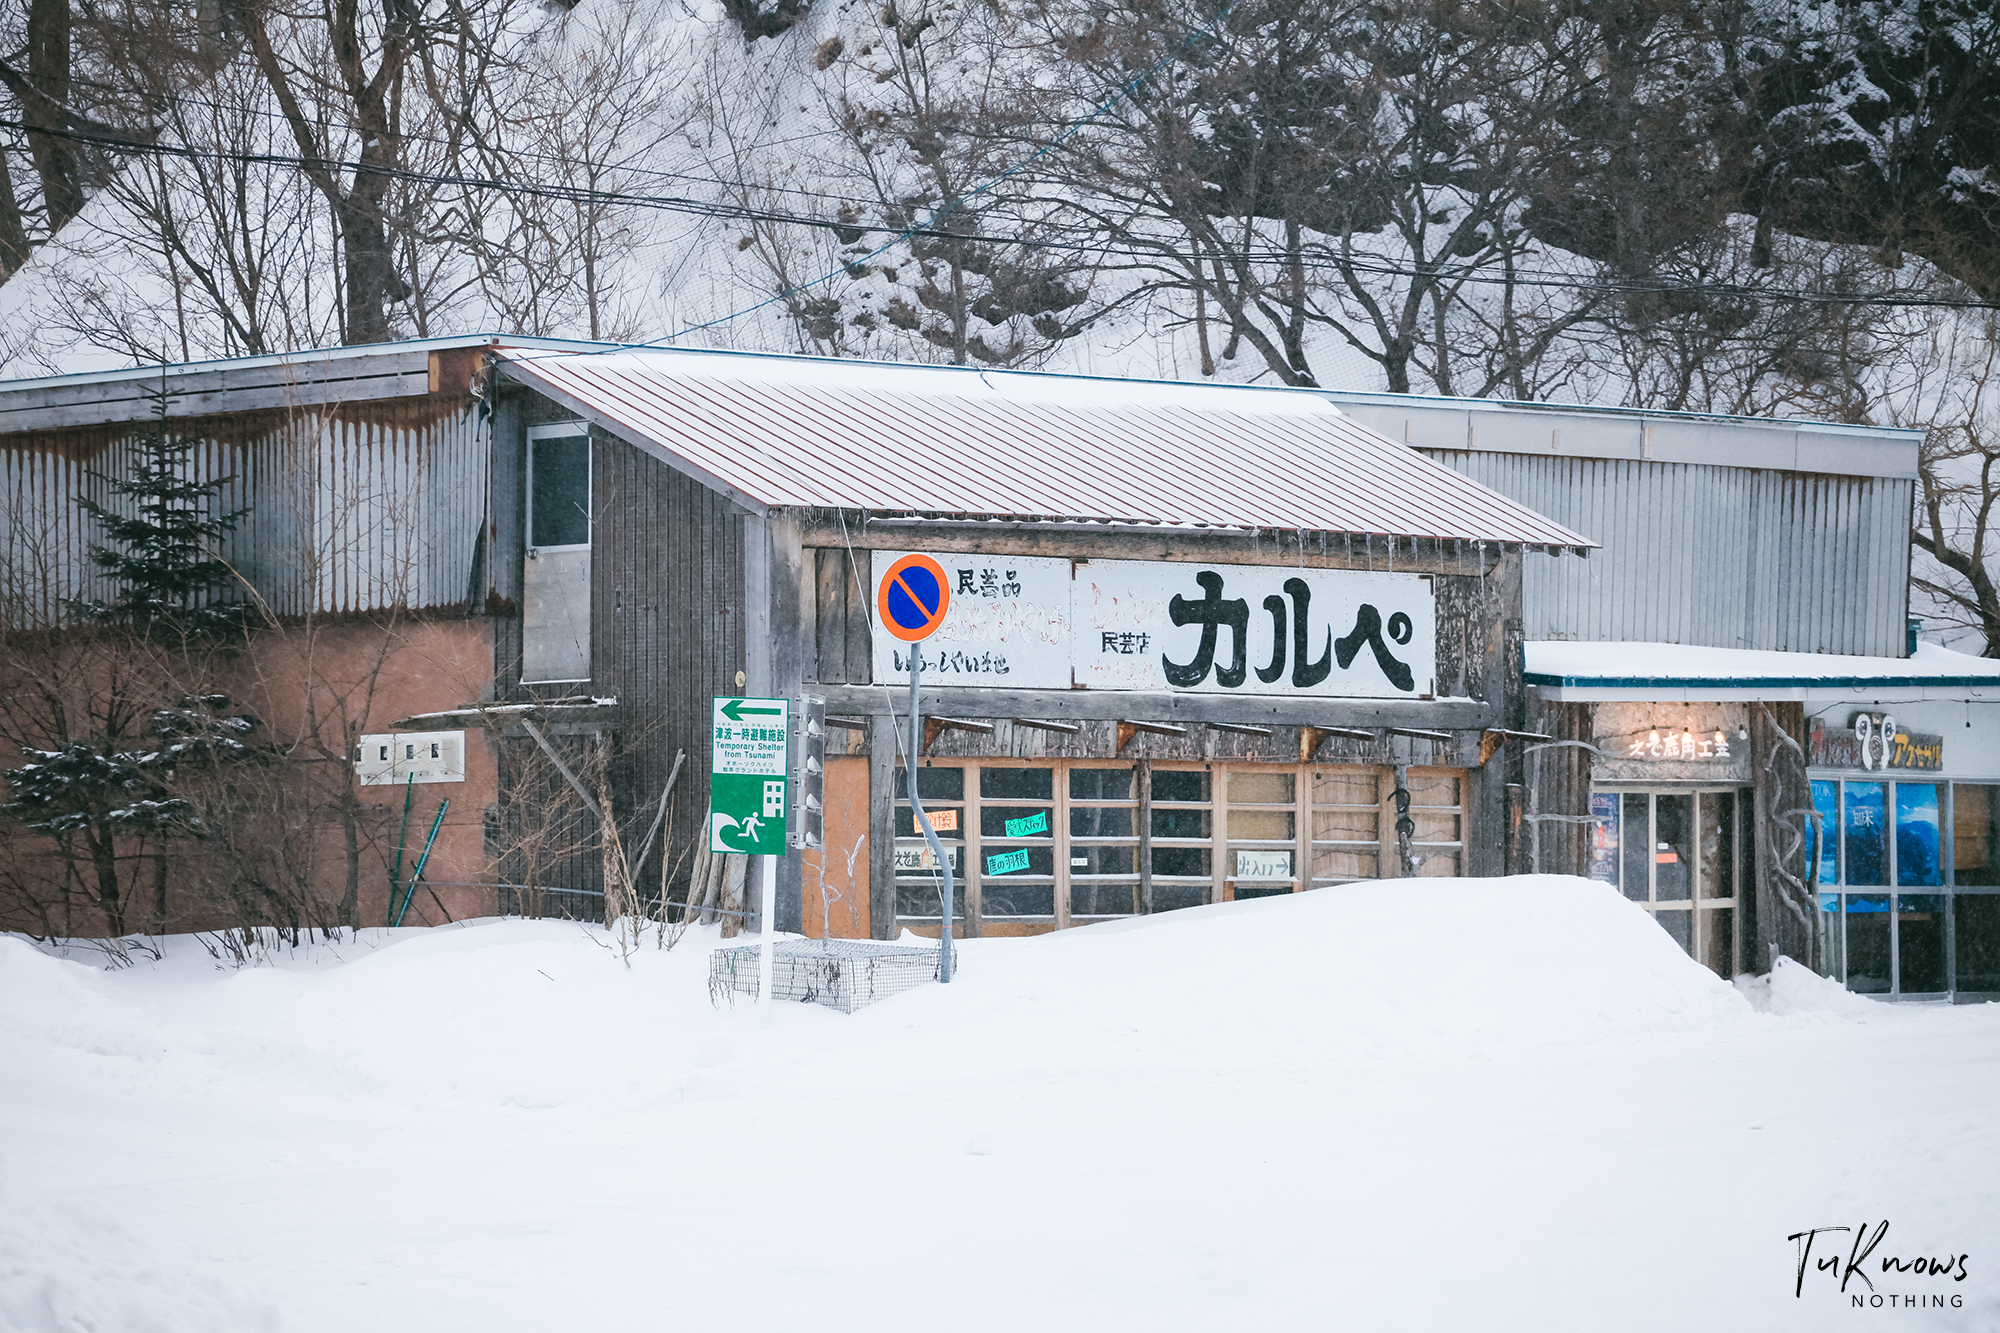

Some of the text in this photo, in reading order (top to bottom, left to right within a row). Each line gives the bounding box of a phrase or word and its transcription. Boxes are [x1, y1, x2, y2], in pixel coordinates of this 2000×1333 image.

[1162, 570, 1415, 691] カルペ
[1101, 631, 1151, 654] 民芸店
[715, 726, 785, 742] 津波一時避難施設
[716, 741, 784, 752] Temporary Shelter
[724, 750, 776, 759] from Tsunami
[1852, 808, 1874, 828] 知床
[1238, 855, 1274, 876] 出入口
